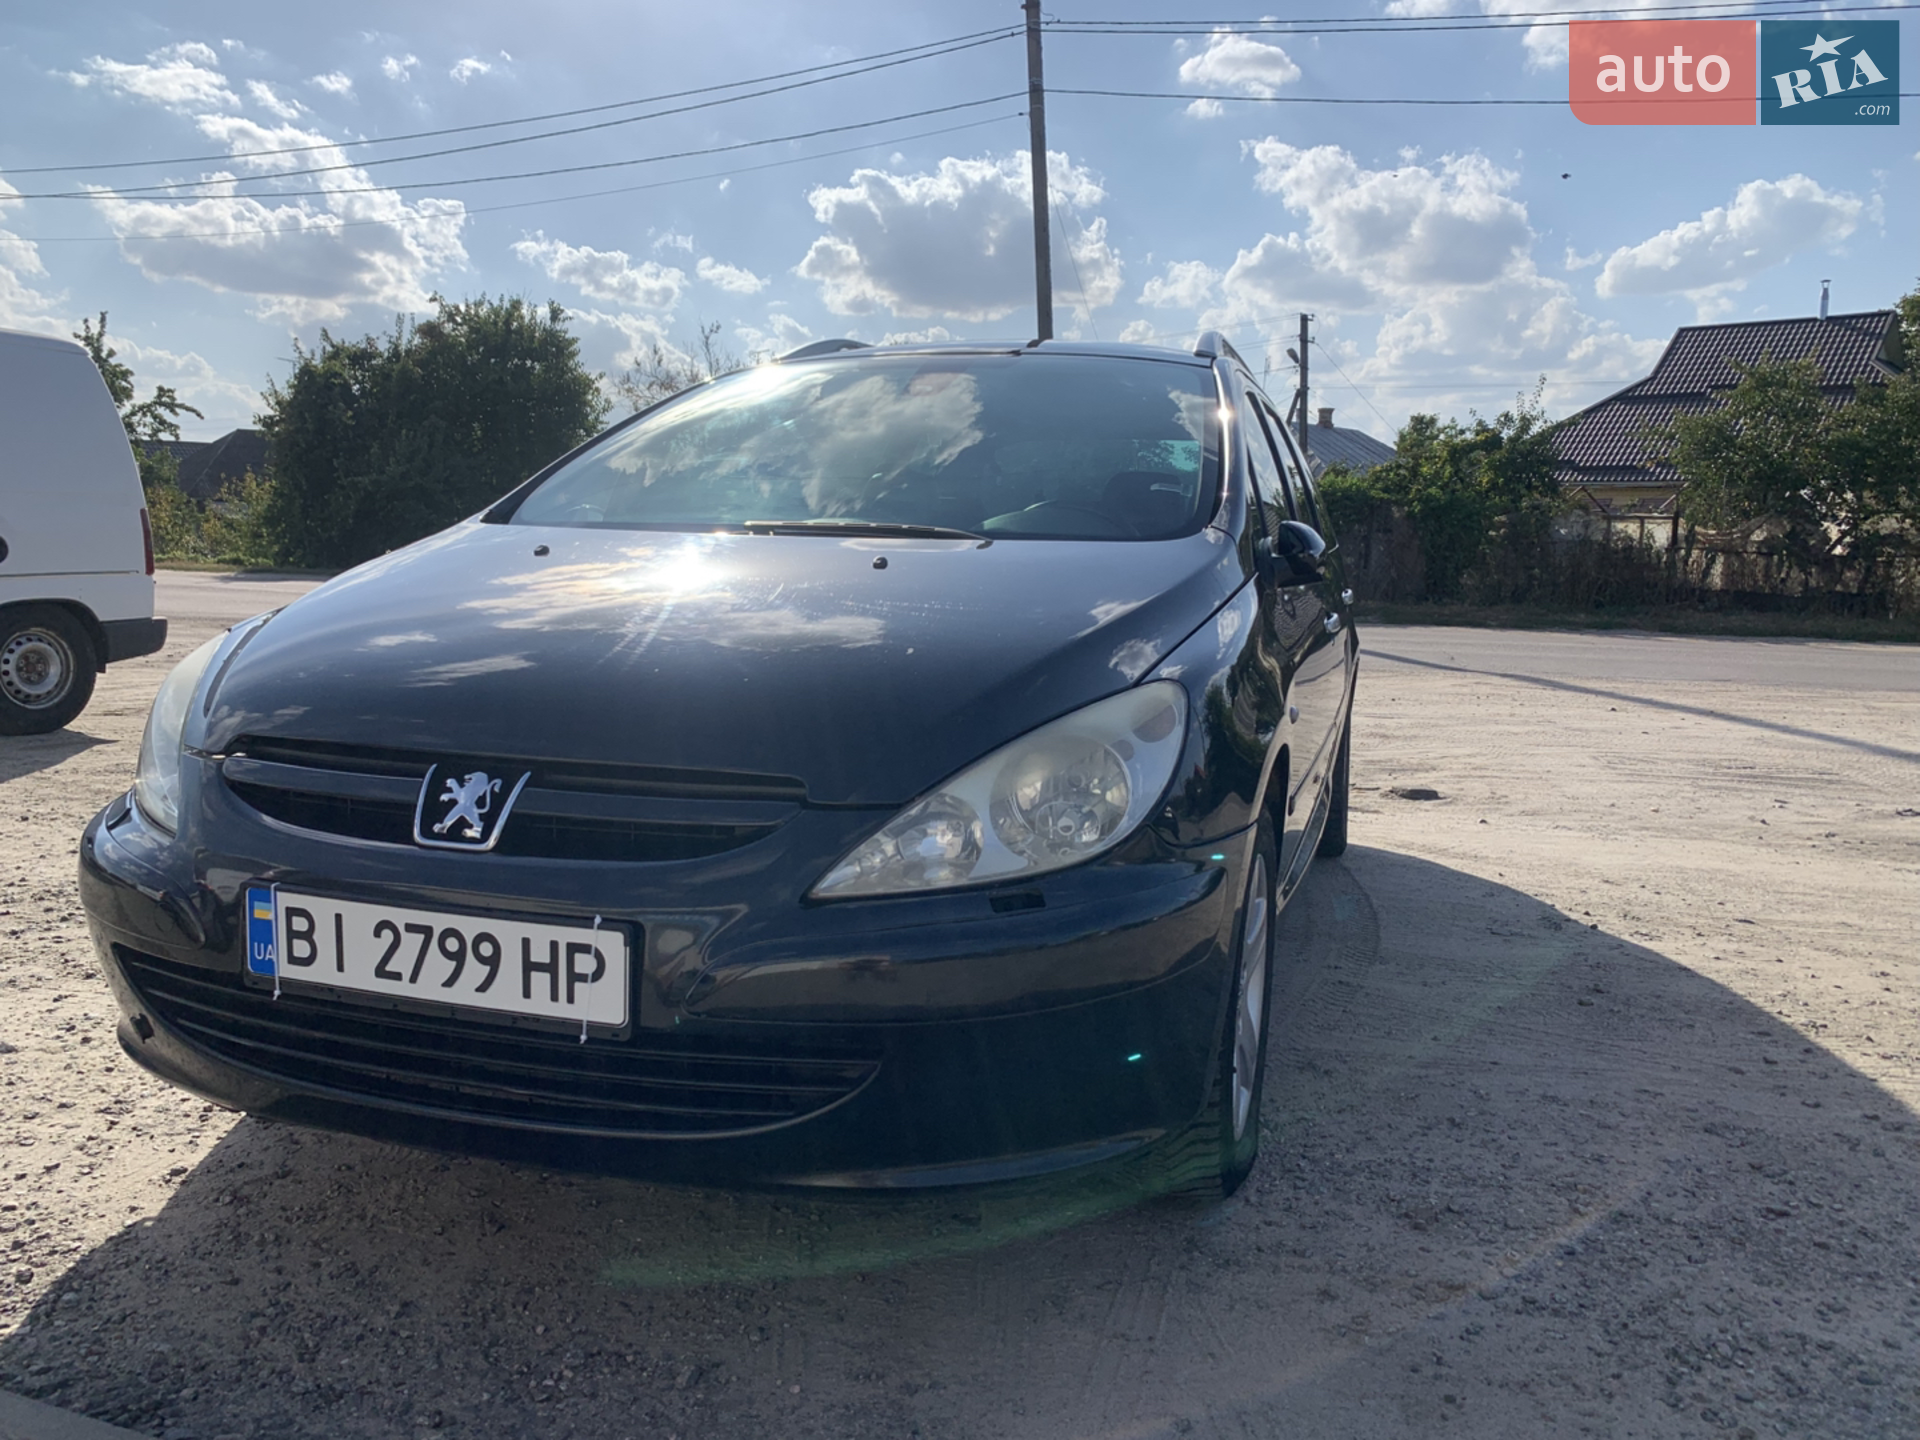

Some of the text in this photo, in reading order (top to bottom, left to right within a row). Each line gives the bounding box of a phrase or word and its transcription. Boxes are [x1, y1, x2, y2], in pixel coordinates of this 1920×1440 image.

[254, 942, 275, 961] UA
[285, 906, 606, 1004] BI 2799 HP
